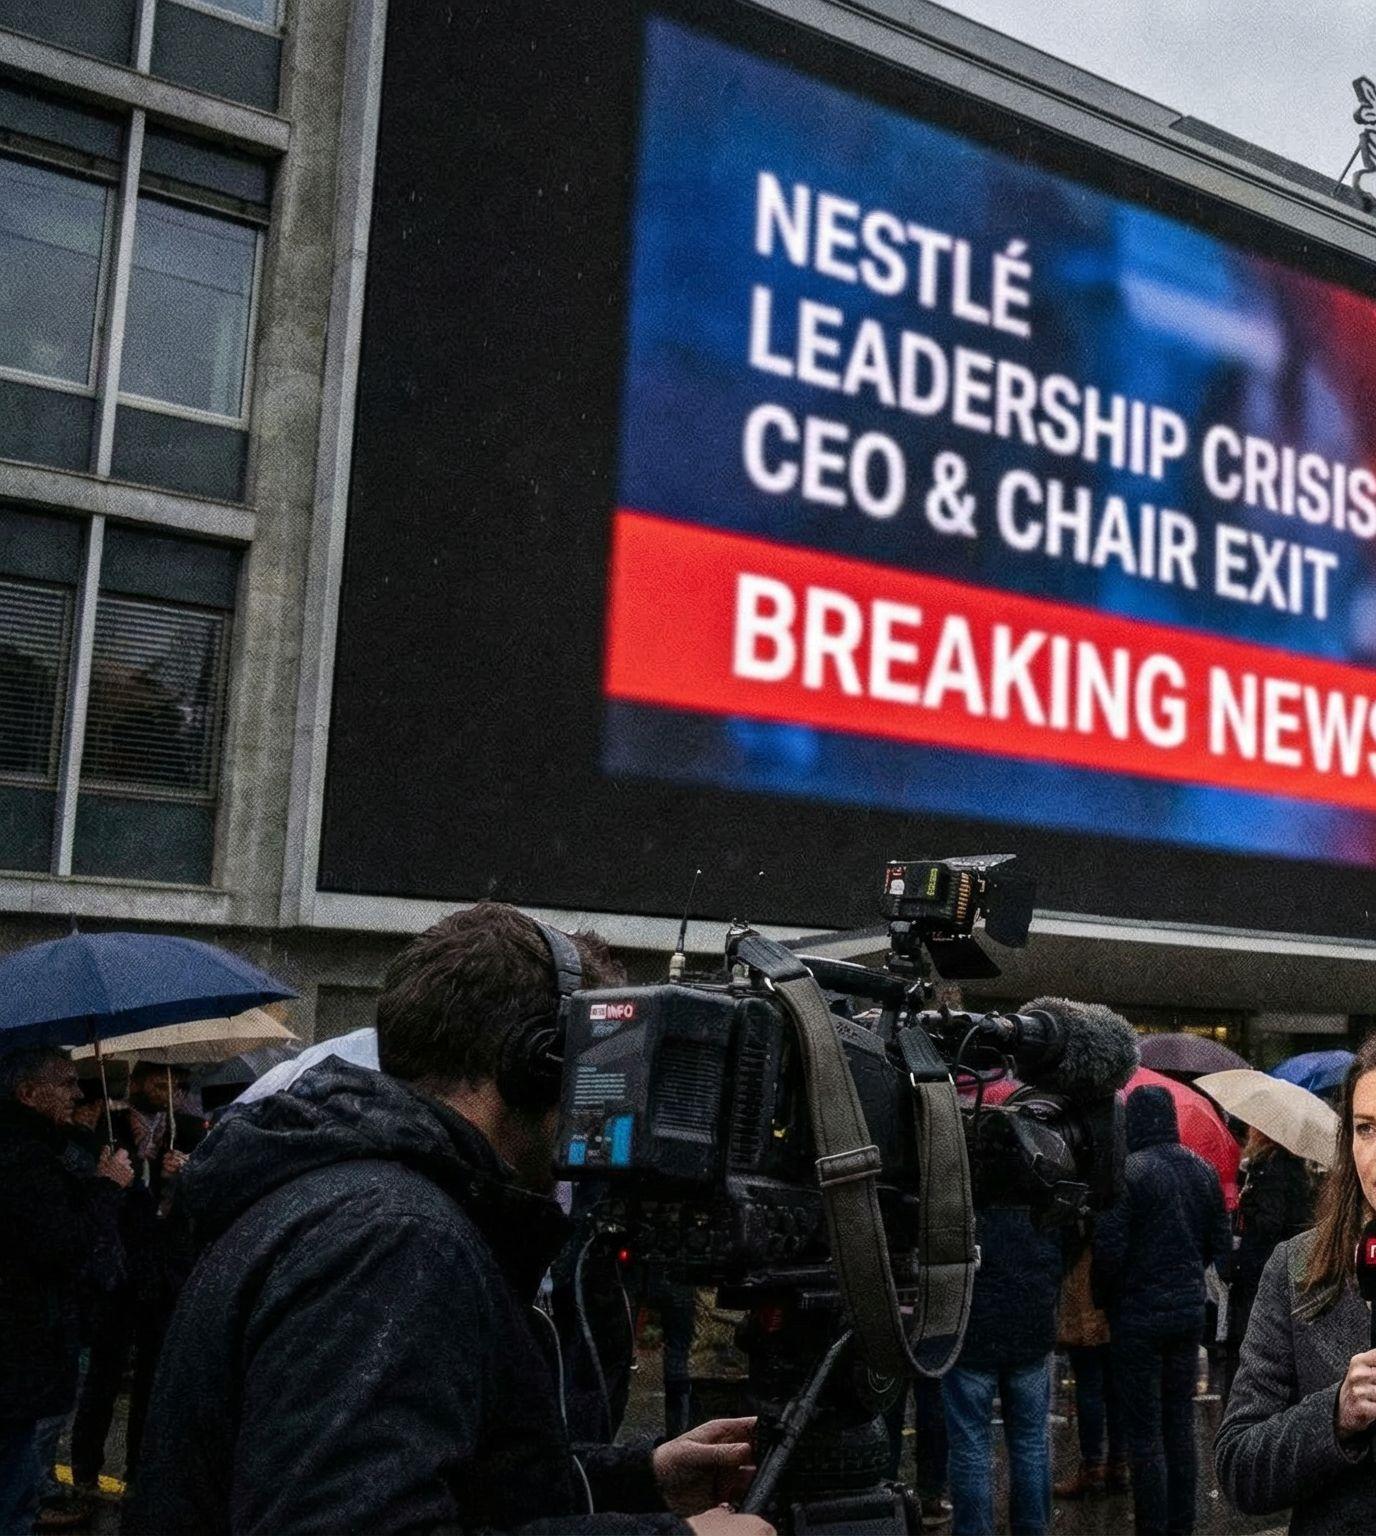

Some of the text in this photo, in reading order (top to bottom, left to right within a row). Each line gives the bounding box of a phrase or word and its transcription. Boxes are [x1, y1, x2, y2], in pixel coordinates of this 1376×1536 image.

[755, 171, 1032, 338] NESTLÉ
[749, 285, 1188, 480] LEADERSHIP
[743, 403, 1339, 620] CEO & CHAIR EXIT
[733, 572, 1187, 749] BREAKING
